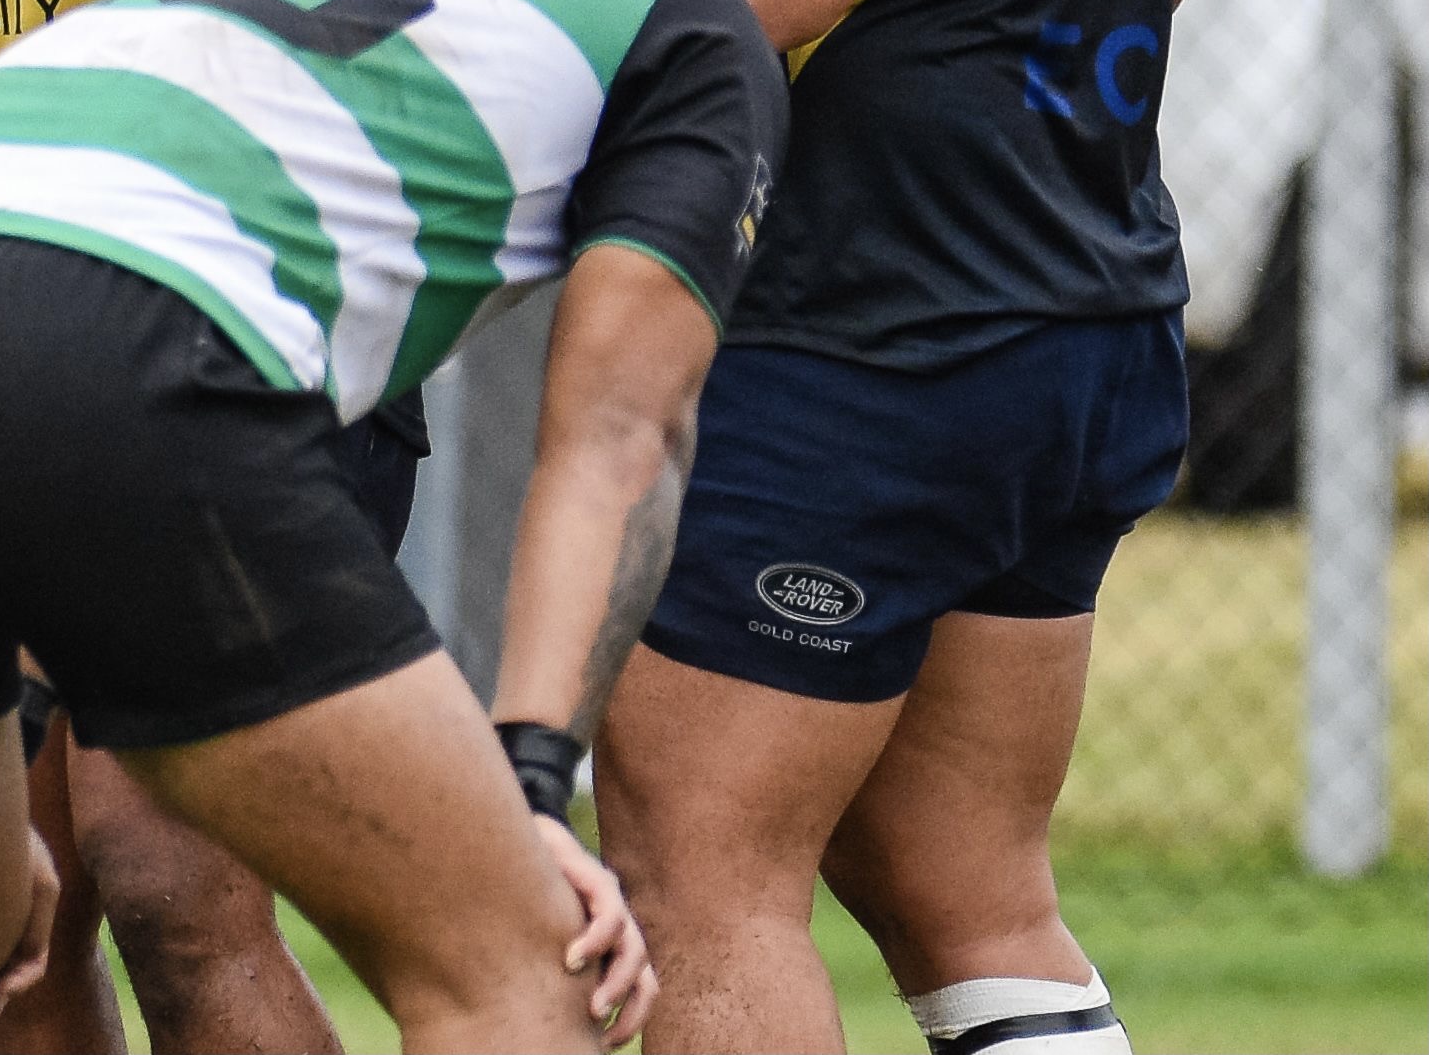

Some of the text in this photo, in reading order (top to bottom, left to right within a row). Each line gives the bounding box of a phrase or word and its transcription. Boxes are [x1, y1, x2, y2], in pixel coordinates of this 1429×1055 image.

[783, 574, 833, 597] LAND
[783, 590, 844, 615] ROVER
[748, 620, 853, 654] GOLD COAST
